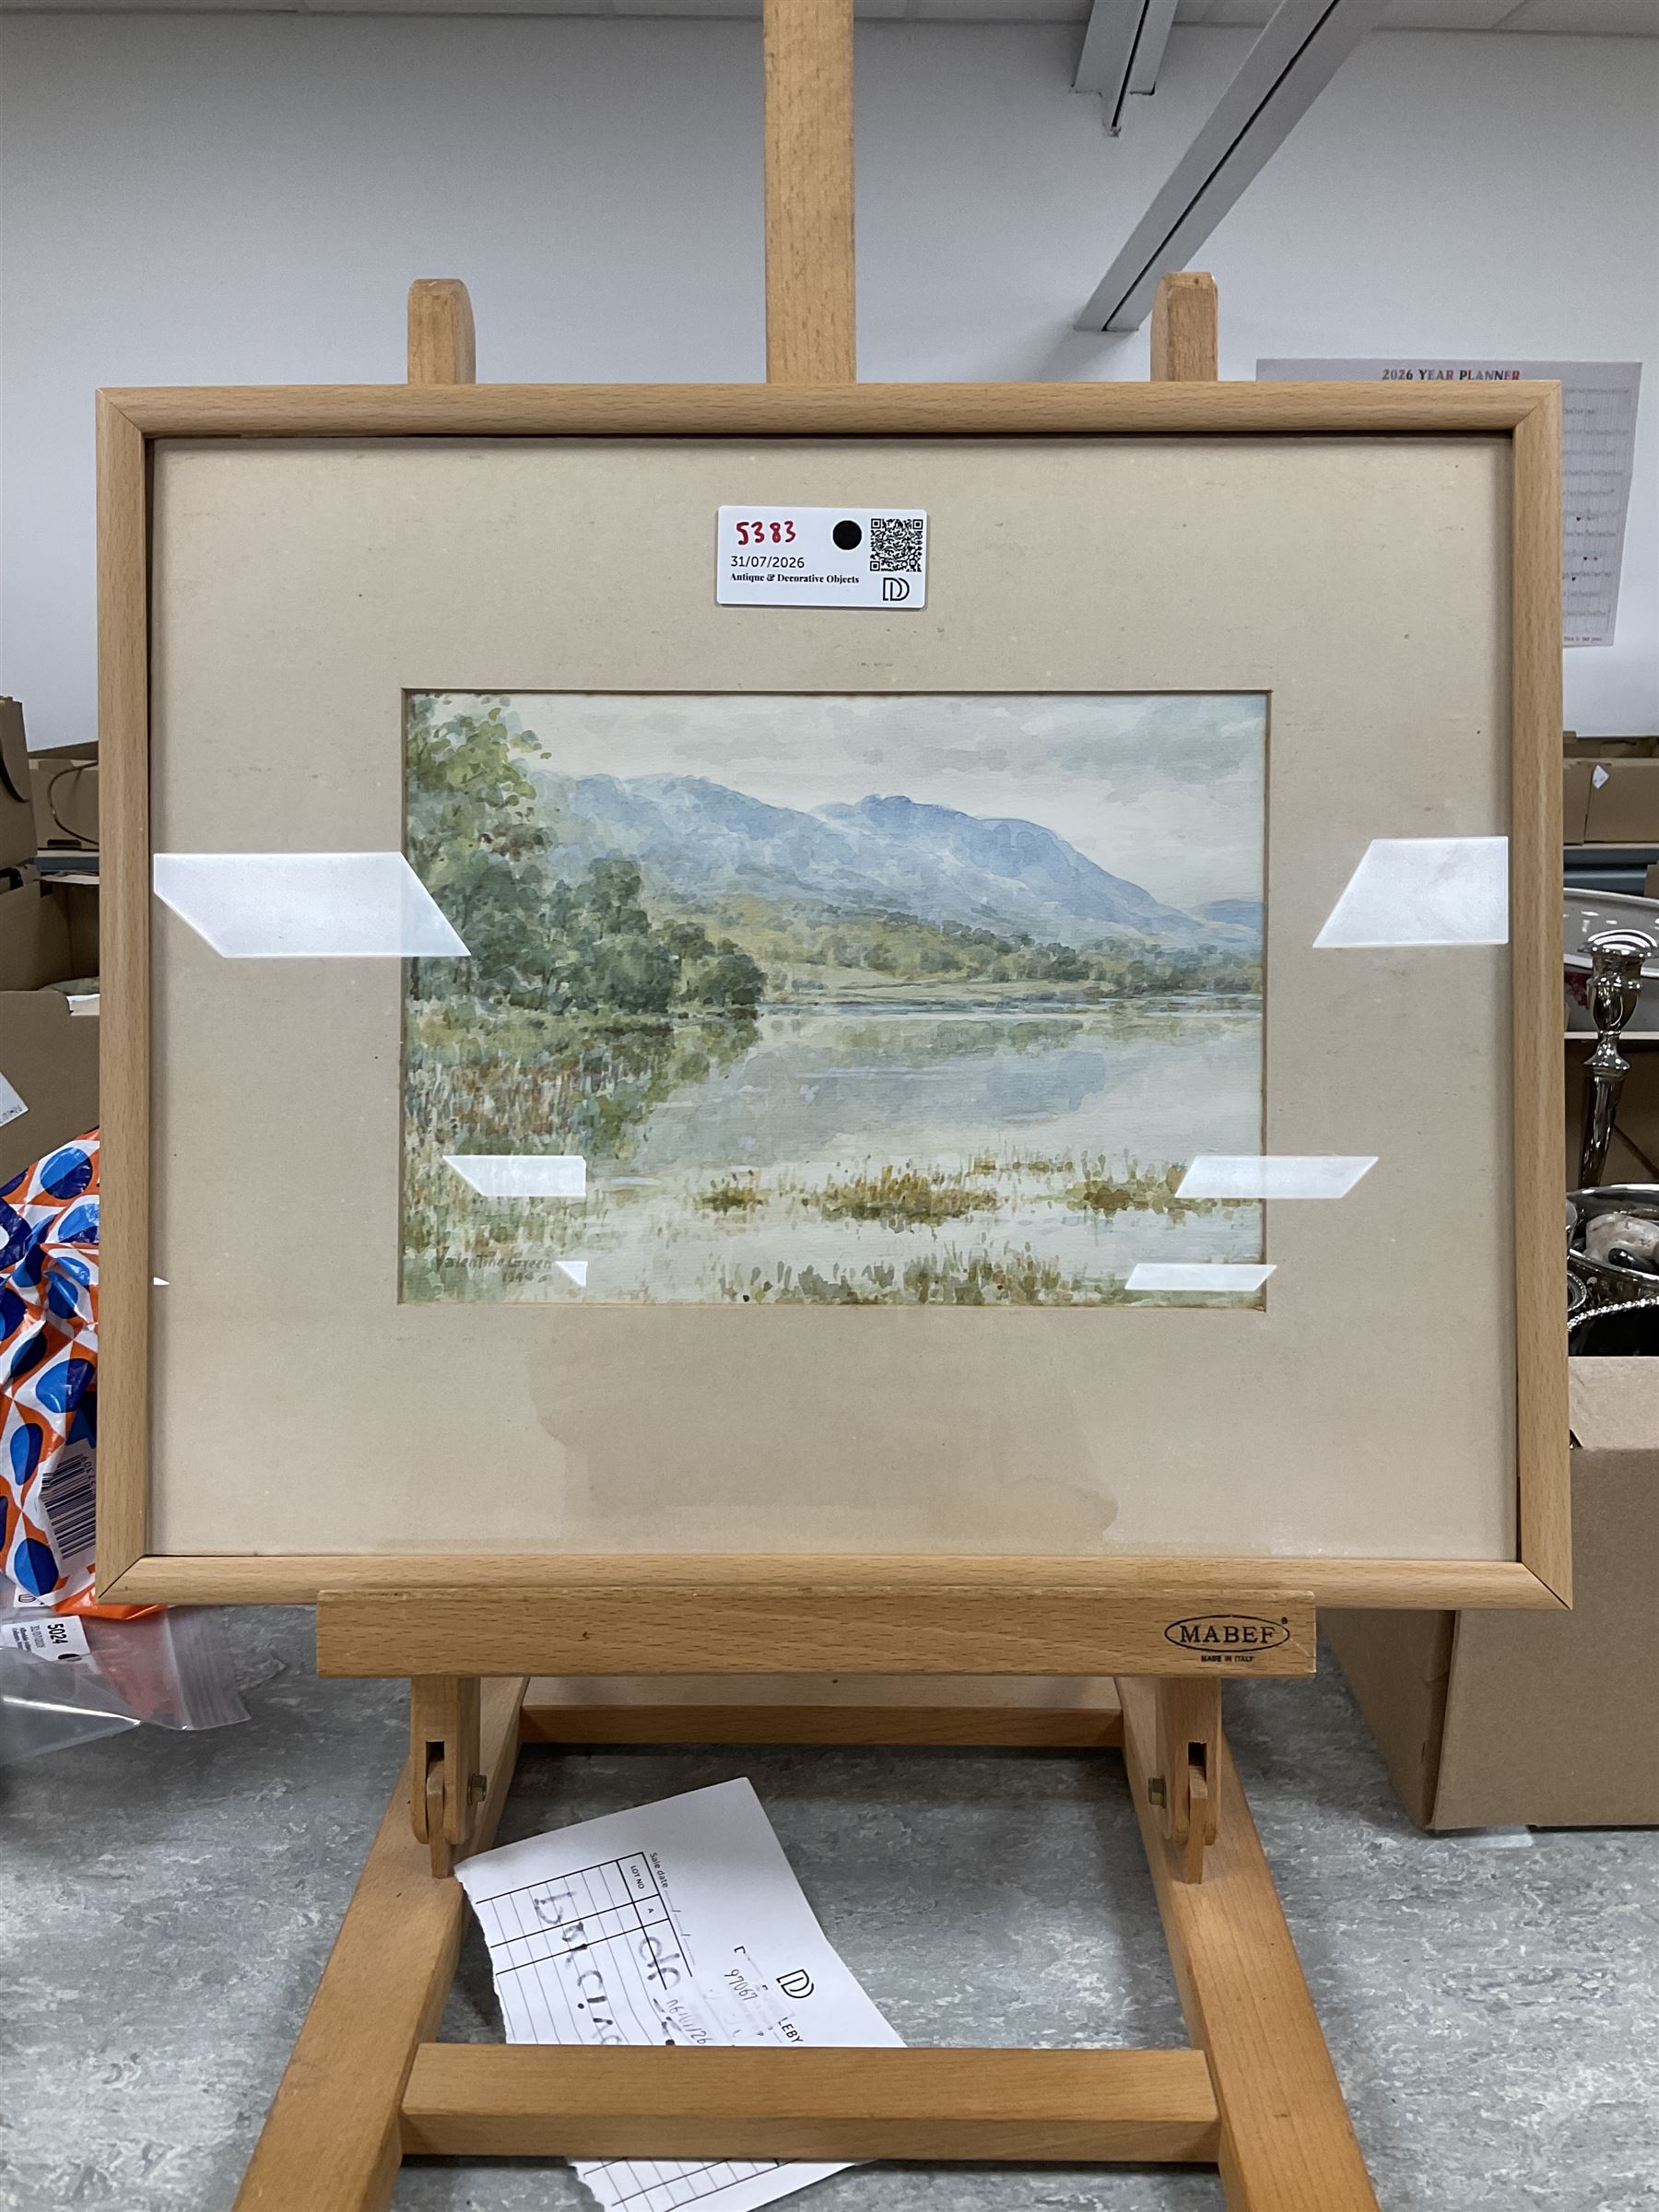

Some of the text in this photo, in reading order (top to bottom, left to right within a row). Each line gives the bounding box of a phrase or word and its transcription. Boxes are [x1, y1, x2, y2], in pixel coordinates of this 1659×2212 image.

[1382, 369, 1521, 381] 2026 YEAR PLANNER
[735, 521, 796, 546] 5383
[730, 555, 805, 569] 31/07/2026
[730, 572, 860, 584] Antique & Decorative Objects
[47, 1623, 68, 1644] 5024
[1180, 1625, 1276, 1643] MABEF
[630, 1865, 645, 1889] LOT NO
[650, 1852, 669, 1888] Sale date
[724, 1969, 758, 2001] 97067
